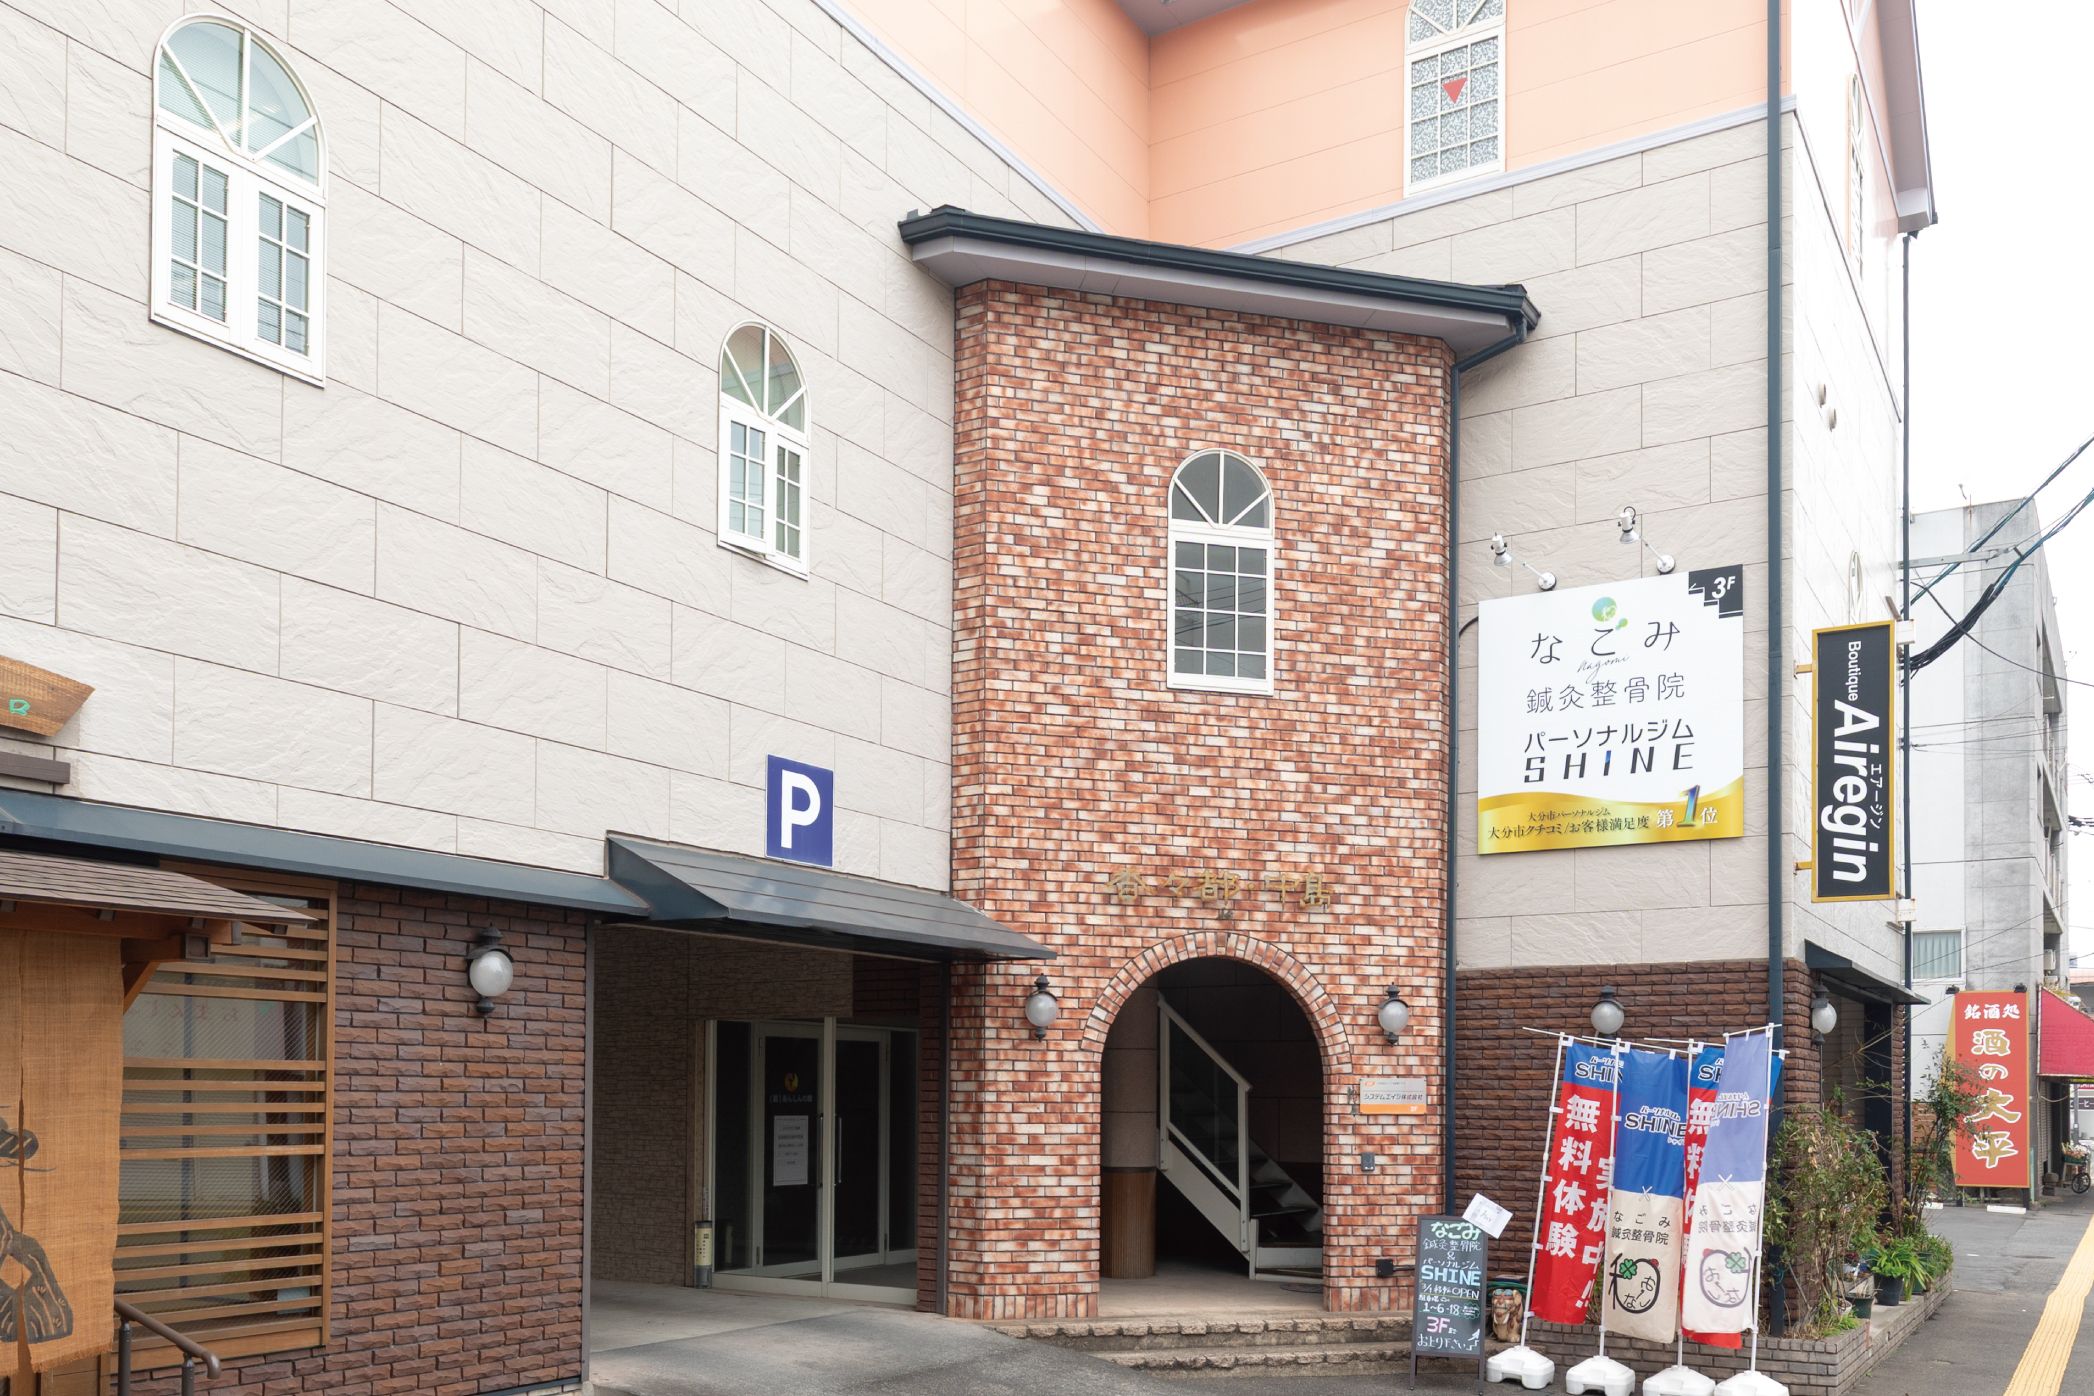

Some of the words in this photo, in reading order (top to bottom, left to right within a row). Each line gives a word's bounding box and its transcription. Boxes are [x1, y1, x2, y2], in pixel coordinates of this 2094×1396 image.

[1711, 575, 1736, 599] 3F
[1848, 640, 1862, 702] Boutique
[1526, 672, 1686, 714] 鍼灸整骨院
[1524, 718, 1695, 754] パーソナルジム
[1523, 742, 1696, 783] SHINE
[781, 769, 821, 849] P
[1820, 699, 1880, 883] Airegin
[1870, 763, 1885, 830] エアージン
[1963, 1003, 2021, 1021] 銘酒処
[1546, 1093, 1601, 1258] 無料体験
[1613, 1210, 1671, 1229] なごみ
[1421, 1264, 1482, 1287] SHINE
